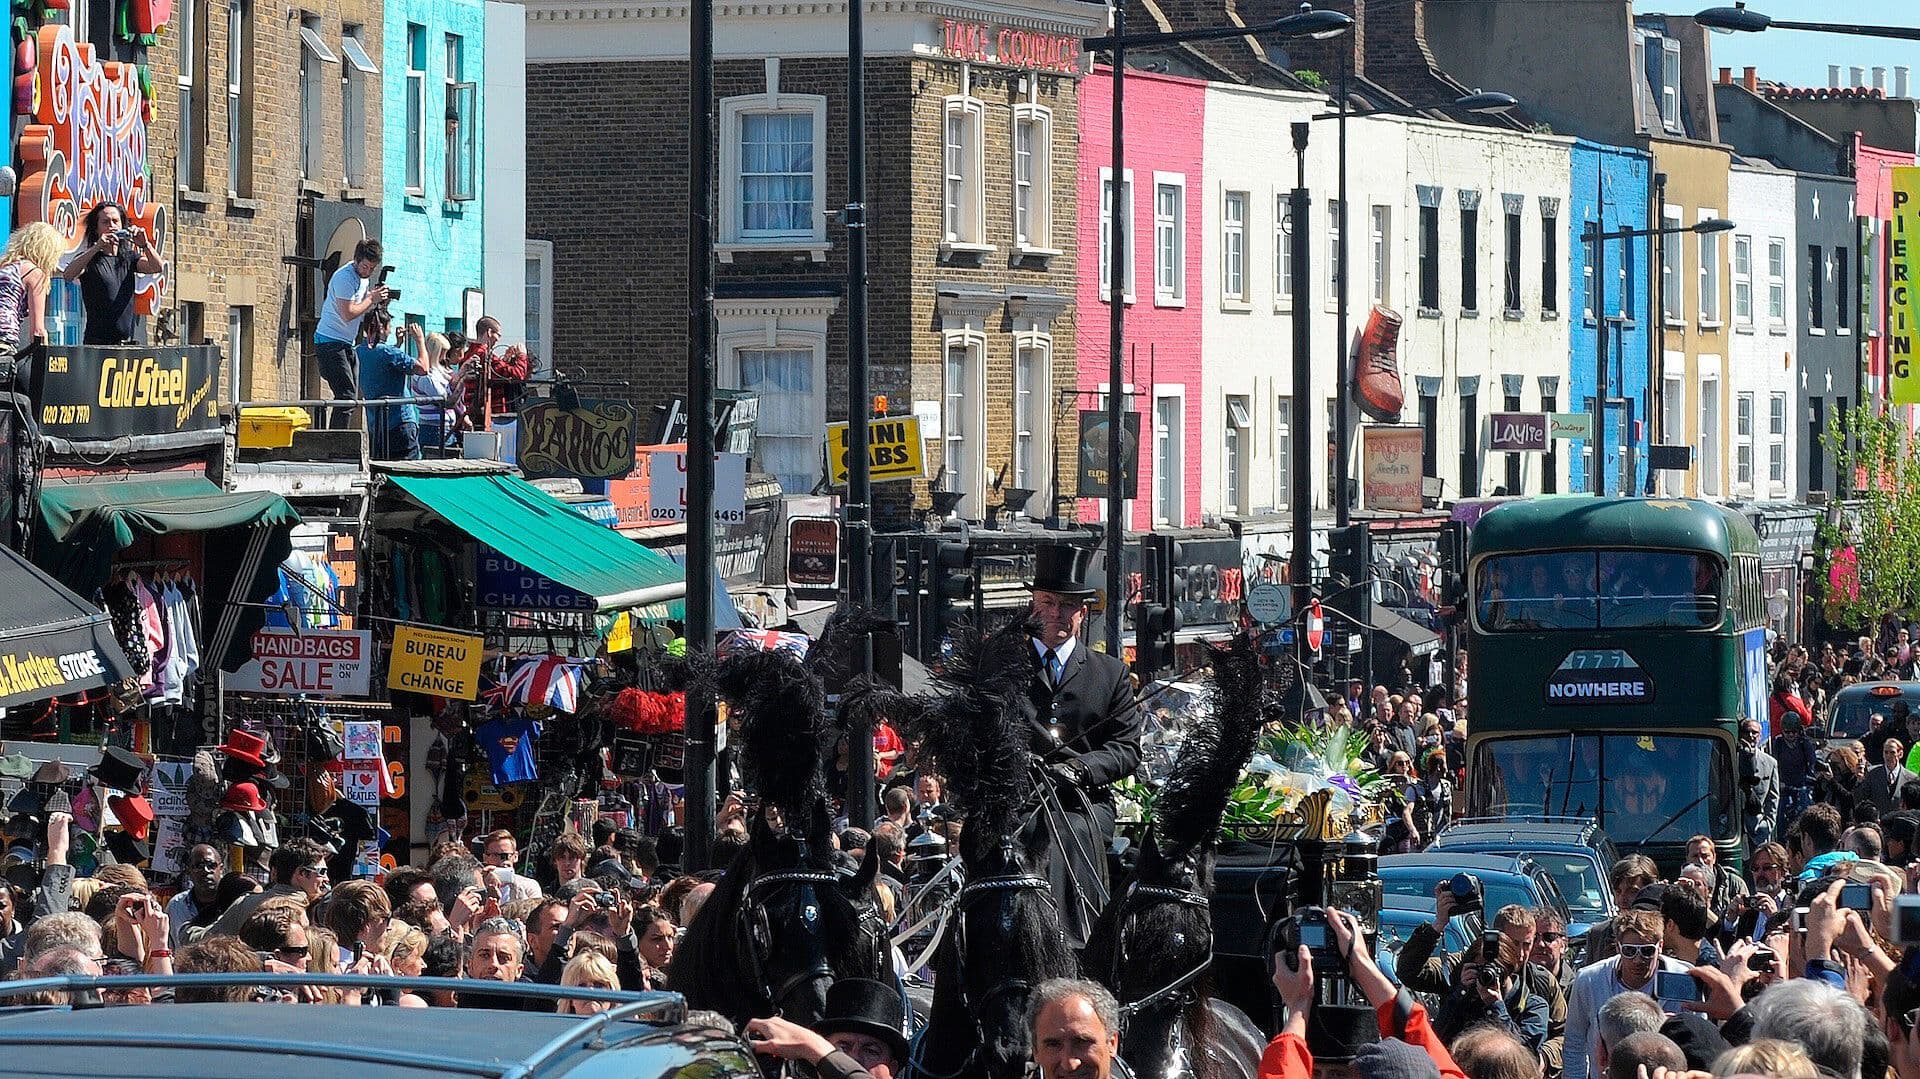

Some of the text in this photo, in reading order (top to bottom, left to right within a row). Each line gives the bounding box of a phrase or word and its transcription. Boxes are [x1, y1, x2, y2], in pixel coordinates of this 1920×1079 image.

[943, 18, 1080, 72] TAKE COURAGE
[1893, 191, 1910, 379] PIERCING
[98, 356, 188, 408] Cold Steel
[42, 405, 58, 425] 020
[651, 508, 676, 519] 020
[520, 577, 550, 590] DE
[485, 593, 590, 608] CHANGE
[253, 636, 354, 658] HANDBAGS
[405, 640, 467, 662] BUREAU
[58, 649, 106, 681] STORE
[338, 662, 360, 672] NOW
[423, 658, 445, 675] DE
[261, 660, 334, 691] SALE
[338, 671, 351, 680] ON
[400, 672, 465, 695] CHANGE
[1549, 681, 1645, 698] NOWHERE
[346, 786, 377, 802] BEATLES
